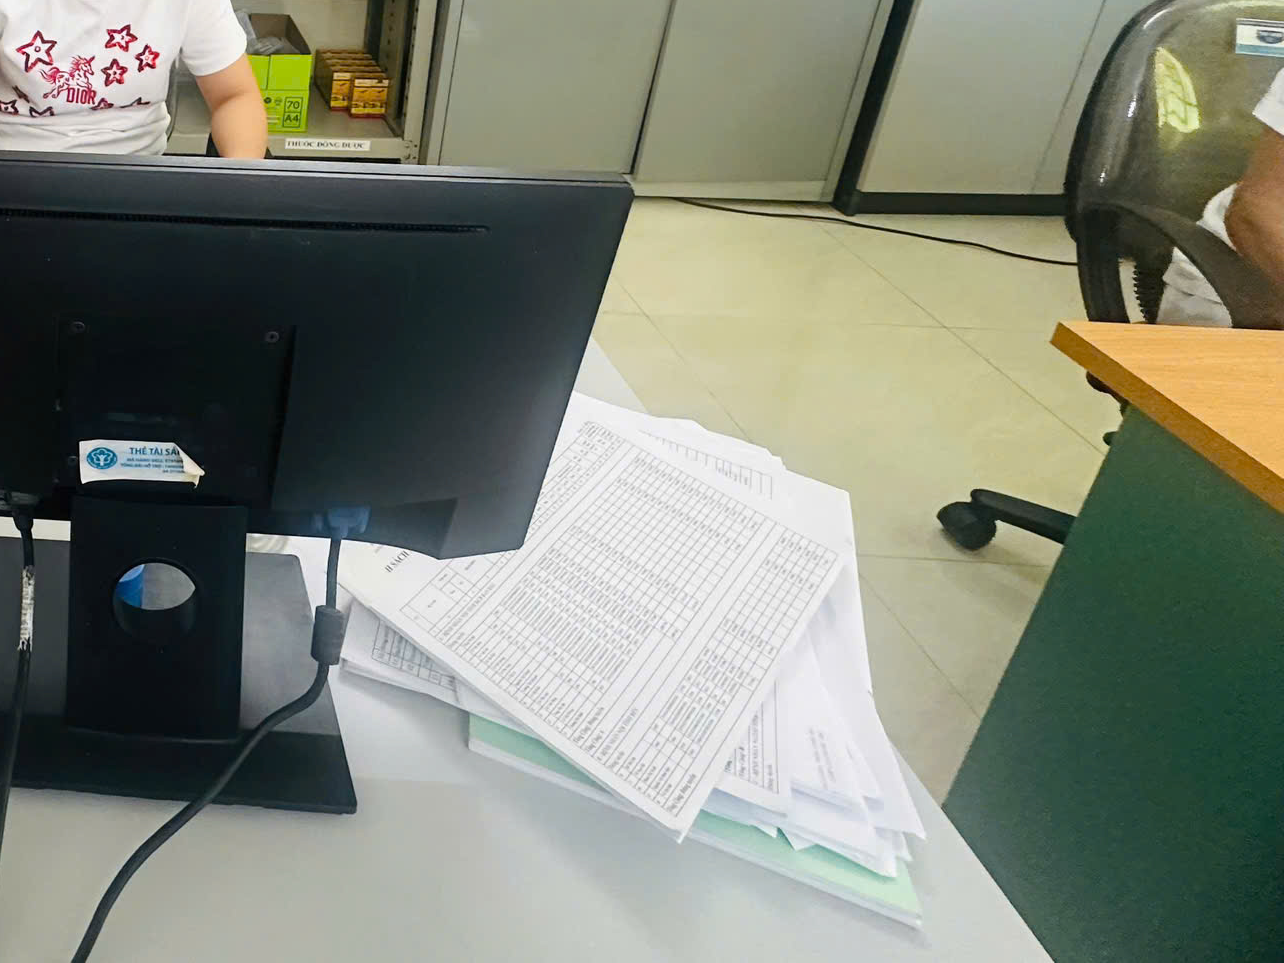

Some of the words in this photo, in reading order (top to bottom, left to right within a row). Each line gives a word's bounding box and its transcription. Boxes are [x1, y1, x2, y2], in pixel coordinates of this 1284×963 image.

[66, 88, 97, 104] DIOR
[286, 100, 300, 110] 70
[285, 114, 299, 123] A4
[149, 446, 163, 455] TÀI
